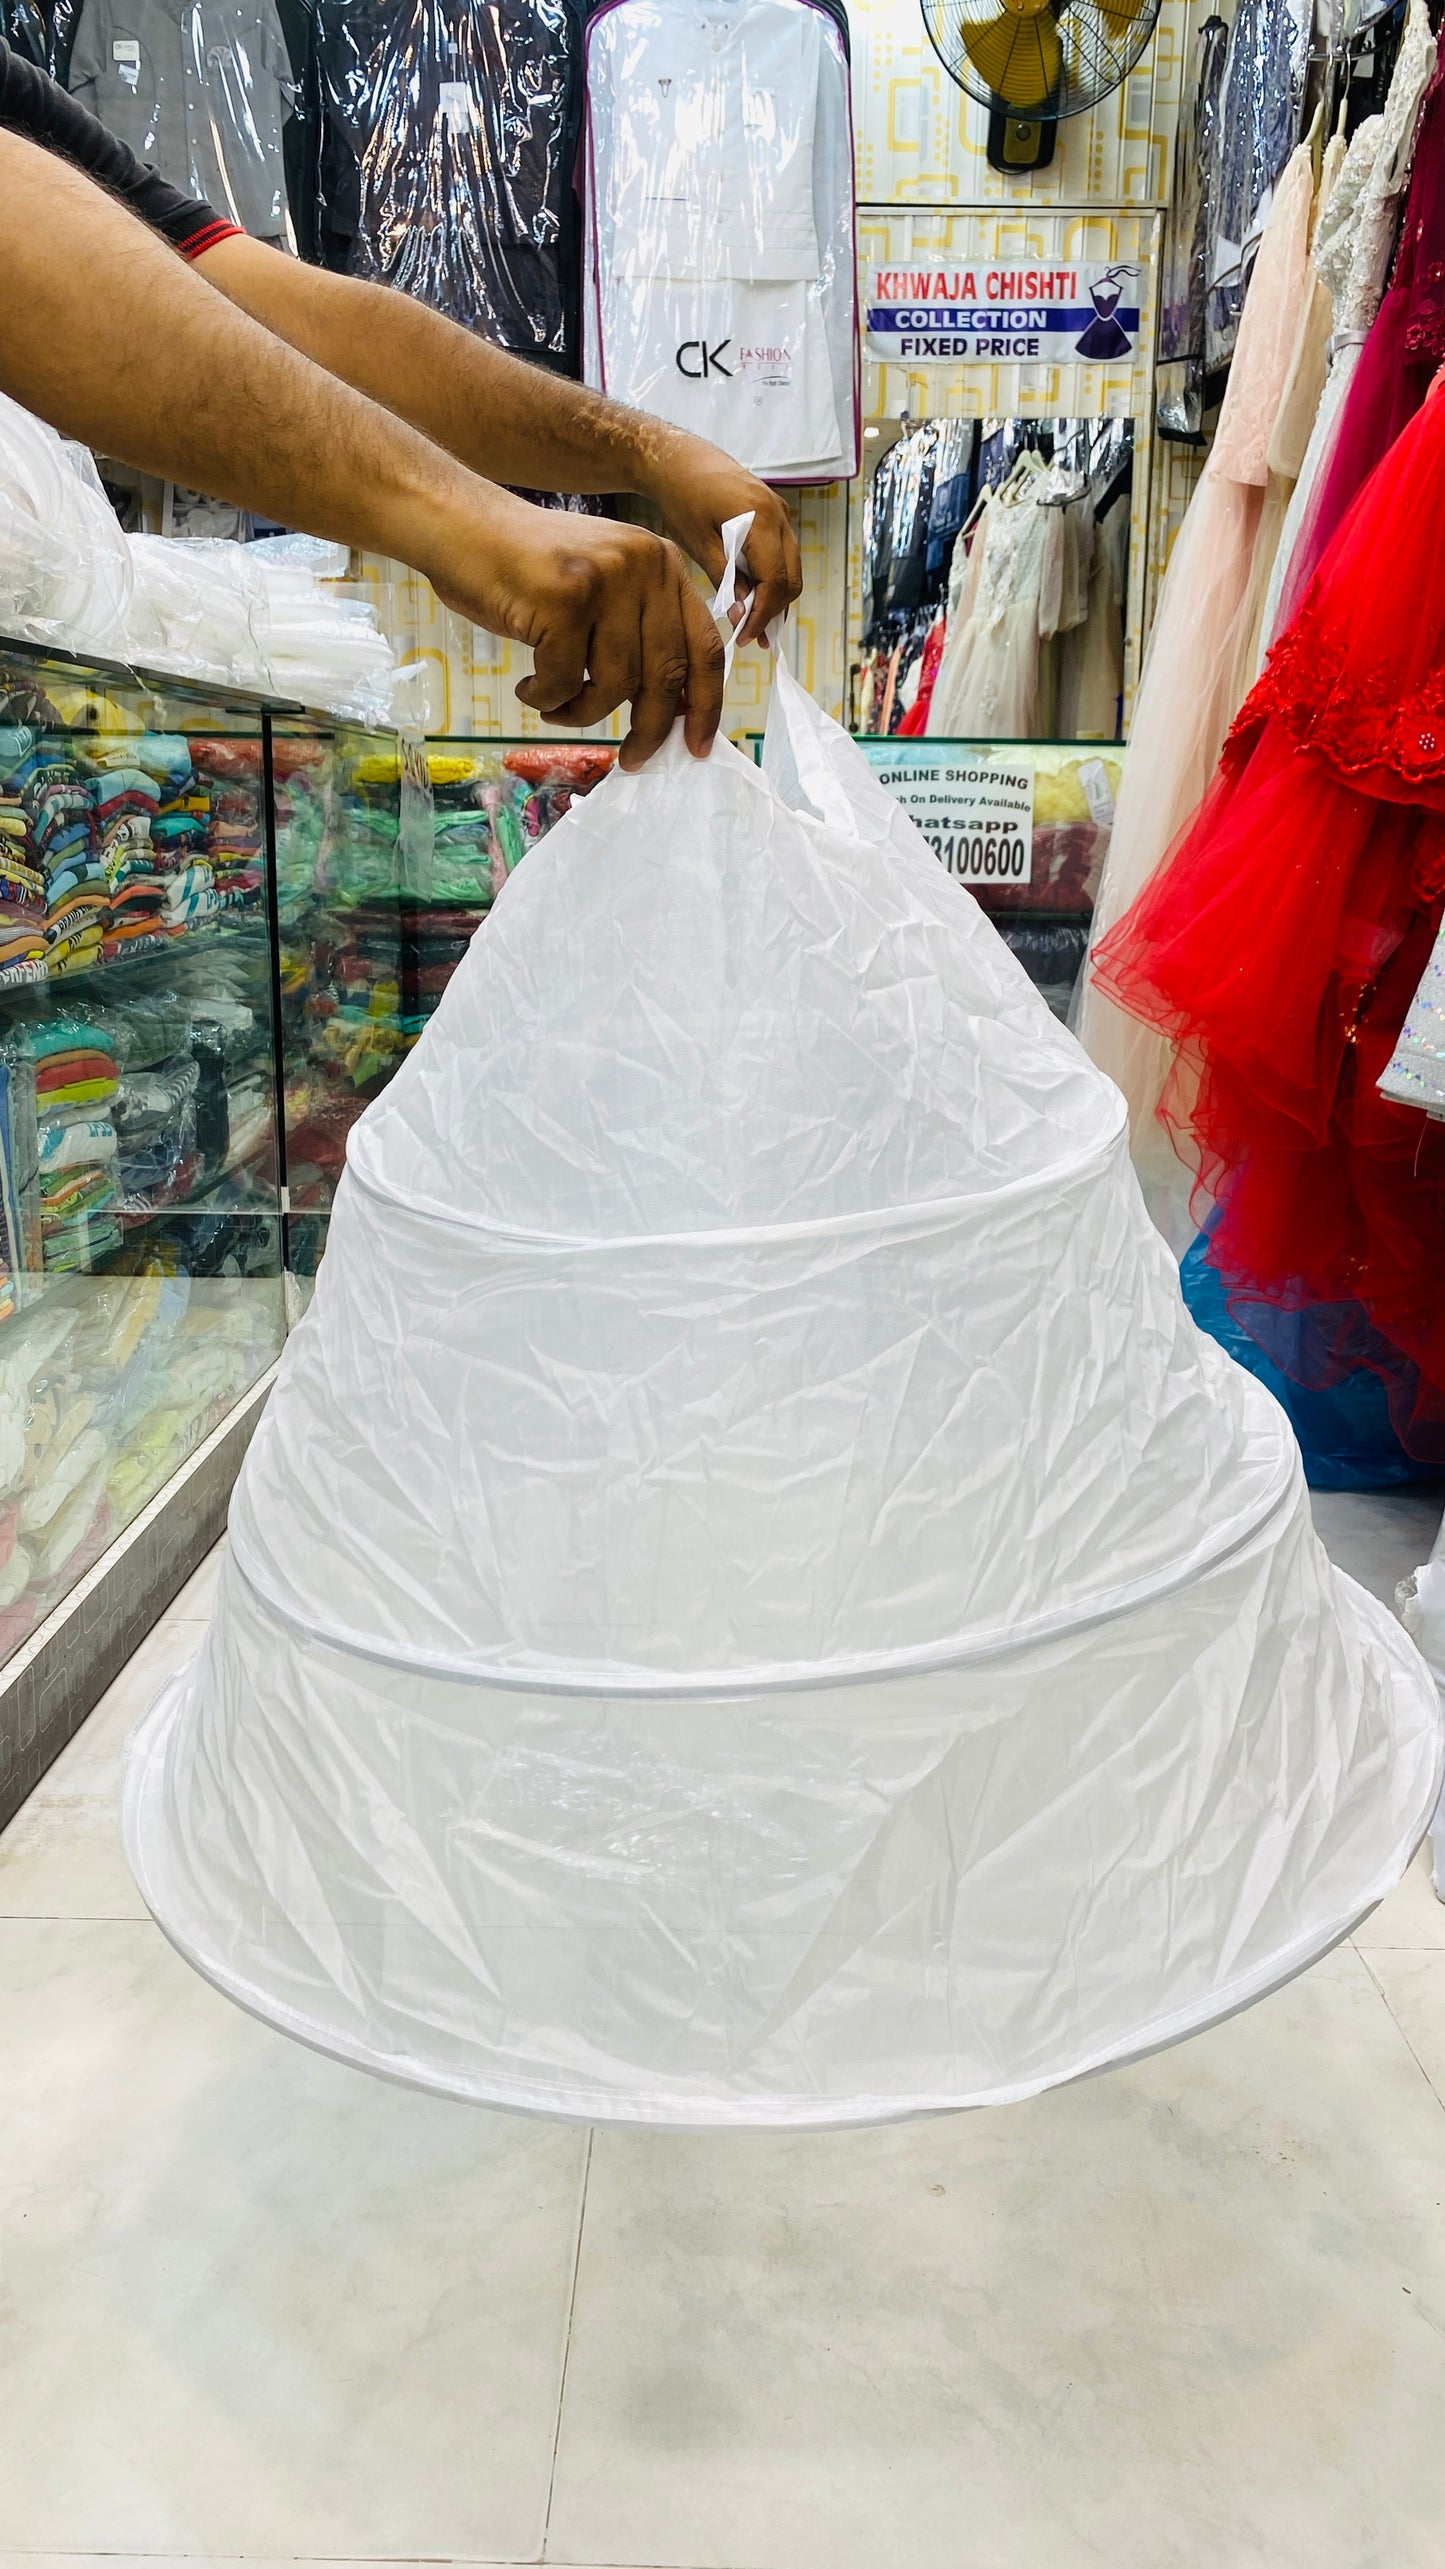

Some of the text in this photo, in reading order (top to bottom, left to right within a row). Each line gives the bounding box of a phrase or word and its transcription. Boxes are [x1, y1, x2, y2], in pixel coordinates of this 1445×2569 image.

[876, 270, 1078, 301] KHWAJA CHISHTI
[894, 310, 1048, 329] COLLECTION
[740, 347, 791, 361] FASHION
[900, 337, 1040, 356] FIXED PRICE
[675, 339, 734, 378] CK
[879, 769, 1029, 790] ONLINE SHOPPING
[910, 794, 926, 804] On
[929, 794, 976, 807] Delivery
[978, 796, 1031, 813] Available
[907, 814, 1019, 834] hatsapp
